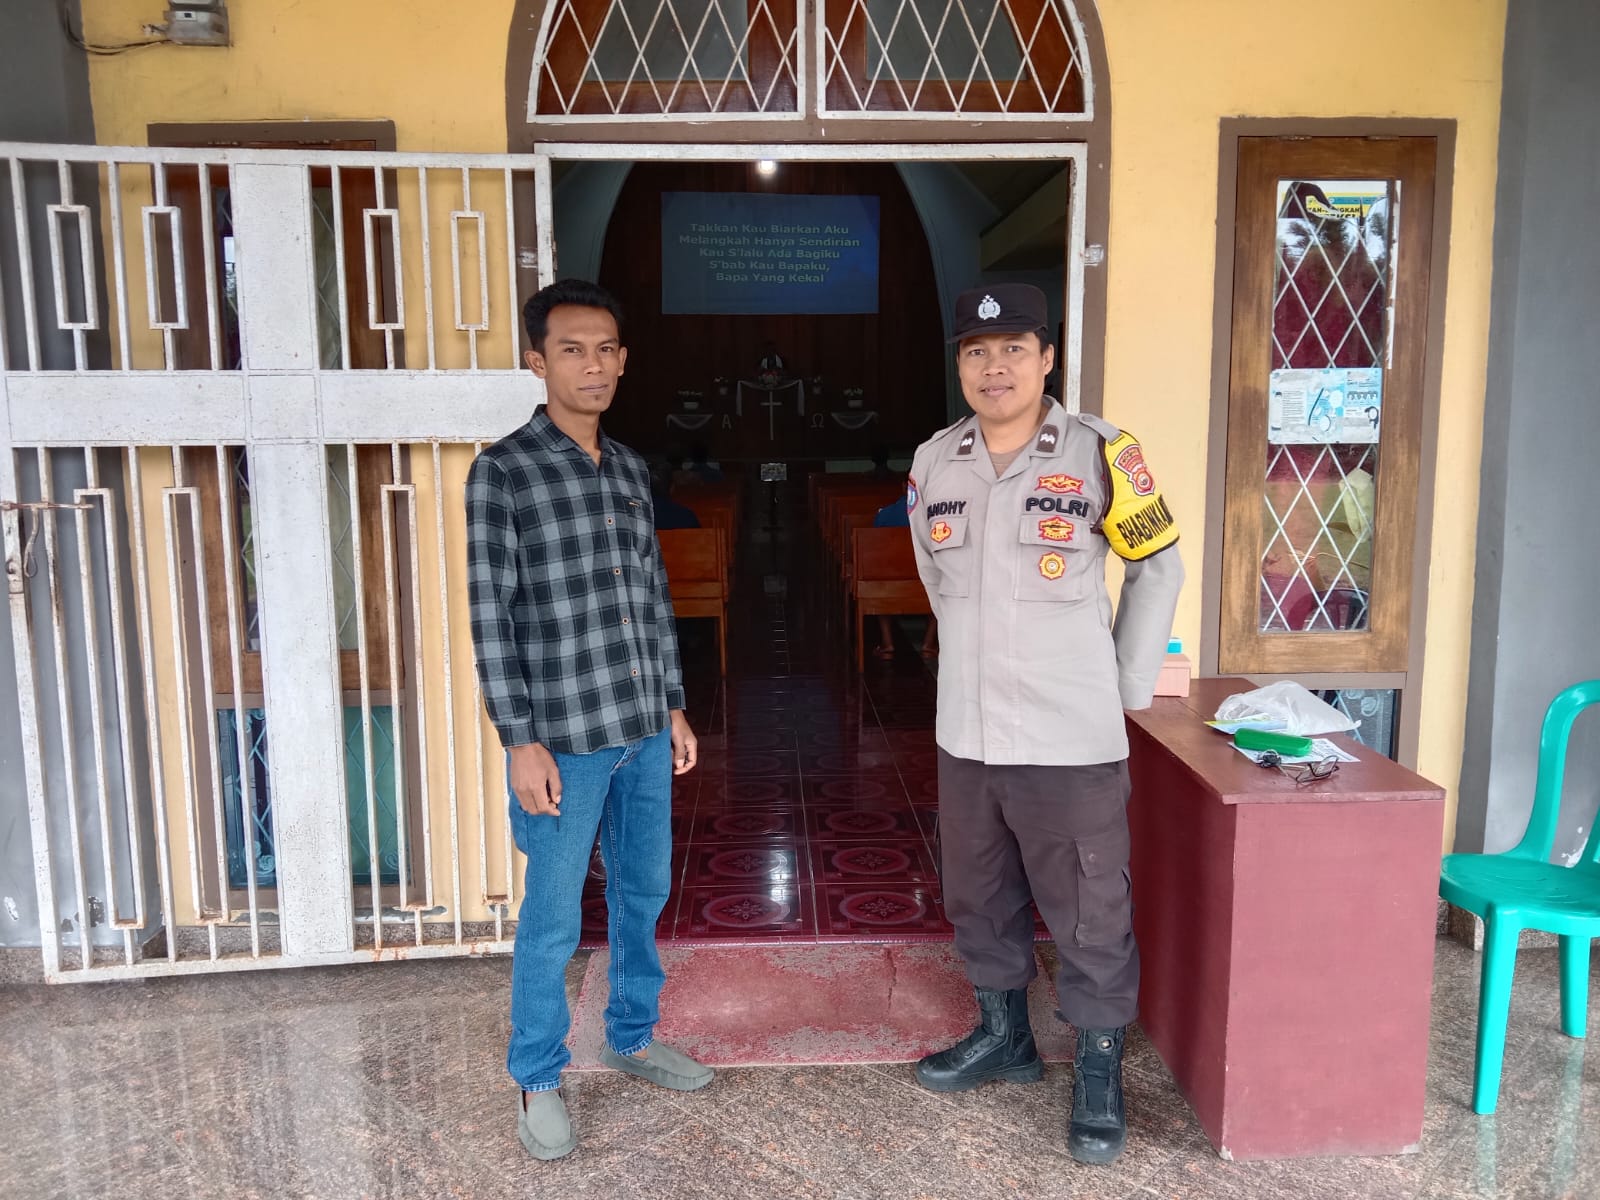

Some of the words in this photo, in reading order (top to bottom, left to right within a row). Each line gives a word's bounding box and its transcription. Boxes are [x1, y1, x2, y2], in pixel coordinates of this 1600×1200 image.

[690, 223, 737, 233] Takkan
[742, 223, 767, 233] Kau
[771, 224, 820, 234] Biarkan
[824, 225, 849, 234] Aku
[679, 235, 750, 247] Melangkah
[754, 236, 795, 248] Hanya
[799, 237, 860, 247] Sendirian
[699, 248, 724, 257] Kau
[768, 249, 792, 258] Ada
[796, 249, 840, 260] Bagiku
[750, 261, 774, 270] Kau
[778, 261, 830, 272] Bapaku,
[716, 272, 748, 283] Bapa
[753, 272, 785, 284] Yang
[789, 273, 824, 283] Kekal
[1026, 497, 1089, 518] POLRI
